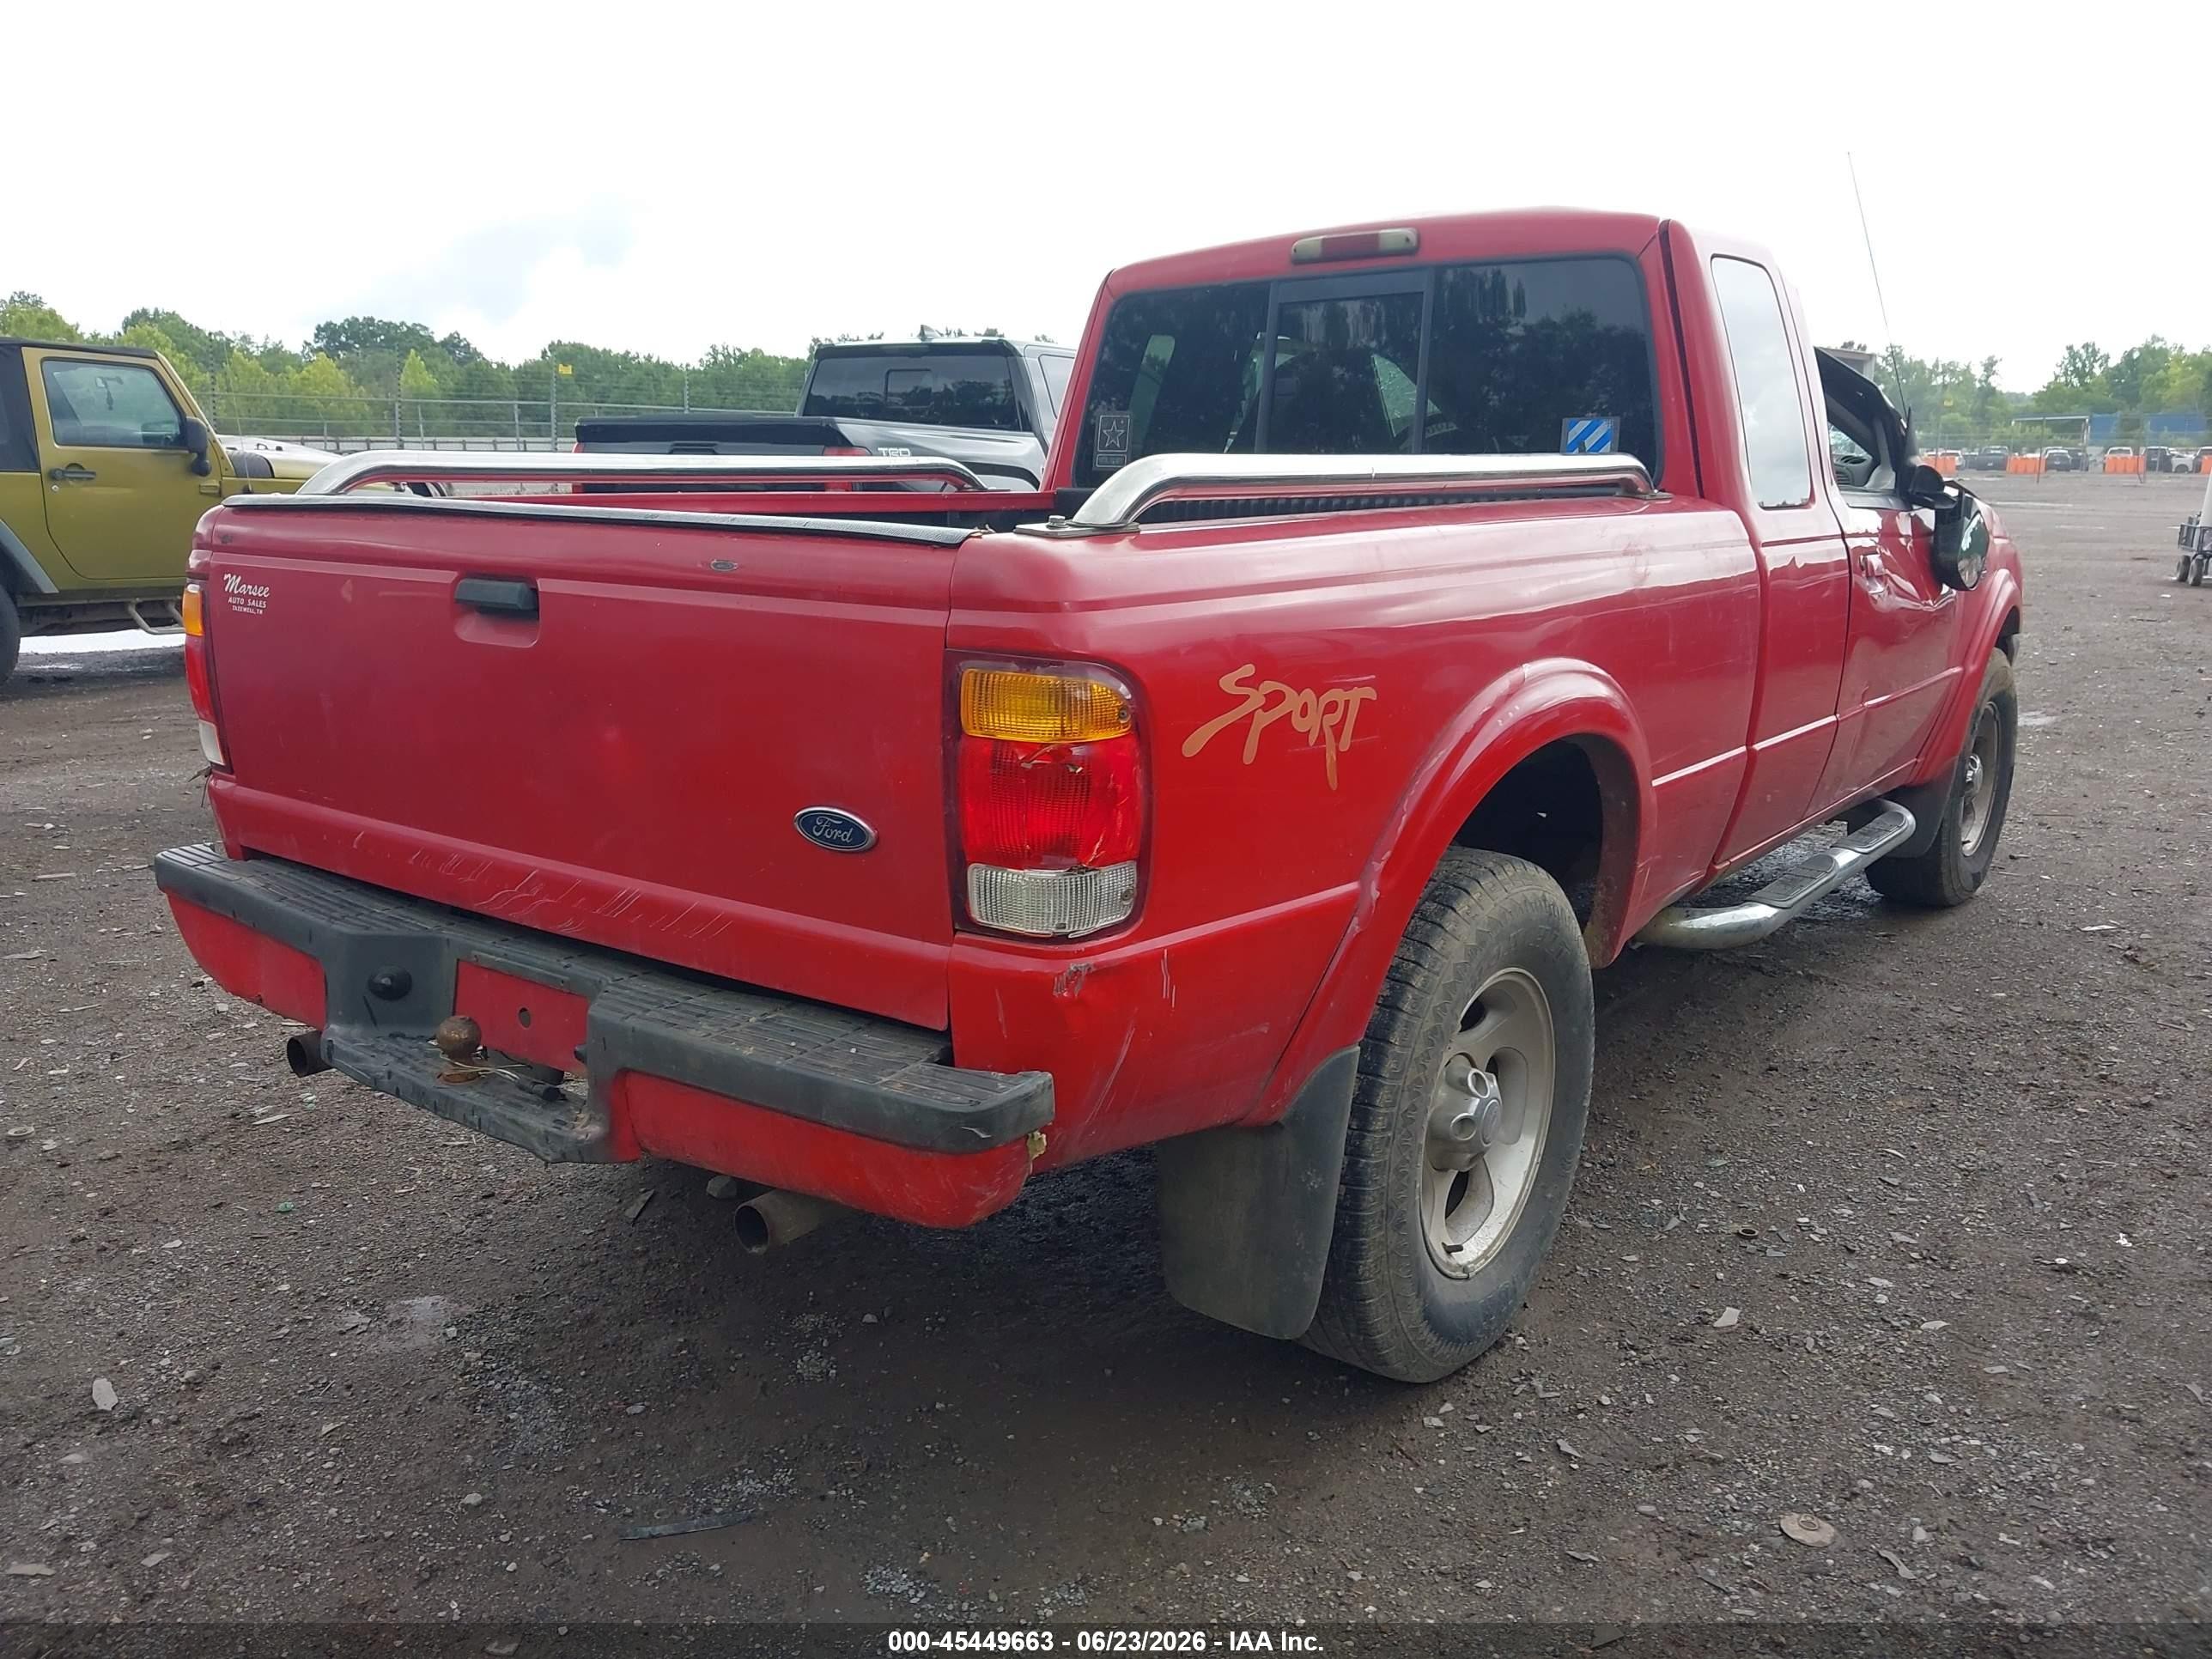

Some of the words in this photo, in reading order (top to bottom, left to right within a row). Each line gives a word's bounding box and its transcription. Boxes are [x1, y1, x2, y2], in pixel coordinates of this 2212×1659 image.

[223, 573, 270, 598] Marsee
[247, 599, 267, 608] SALES
[812, 816, 854, 843] Ford
